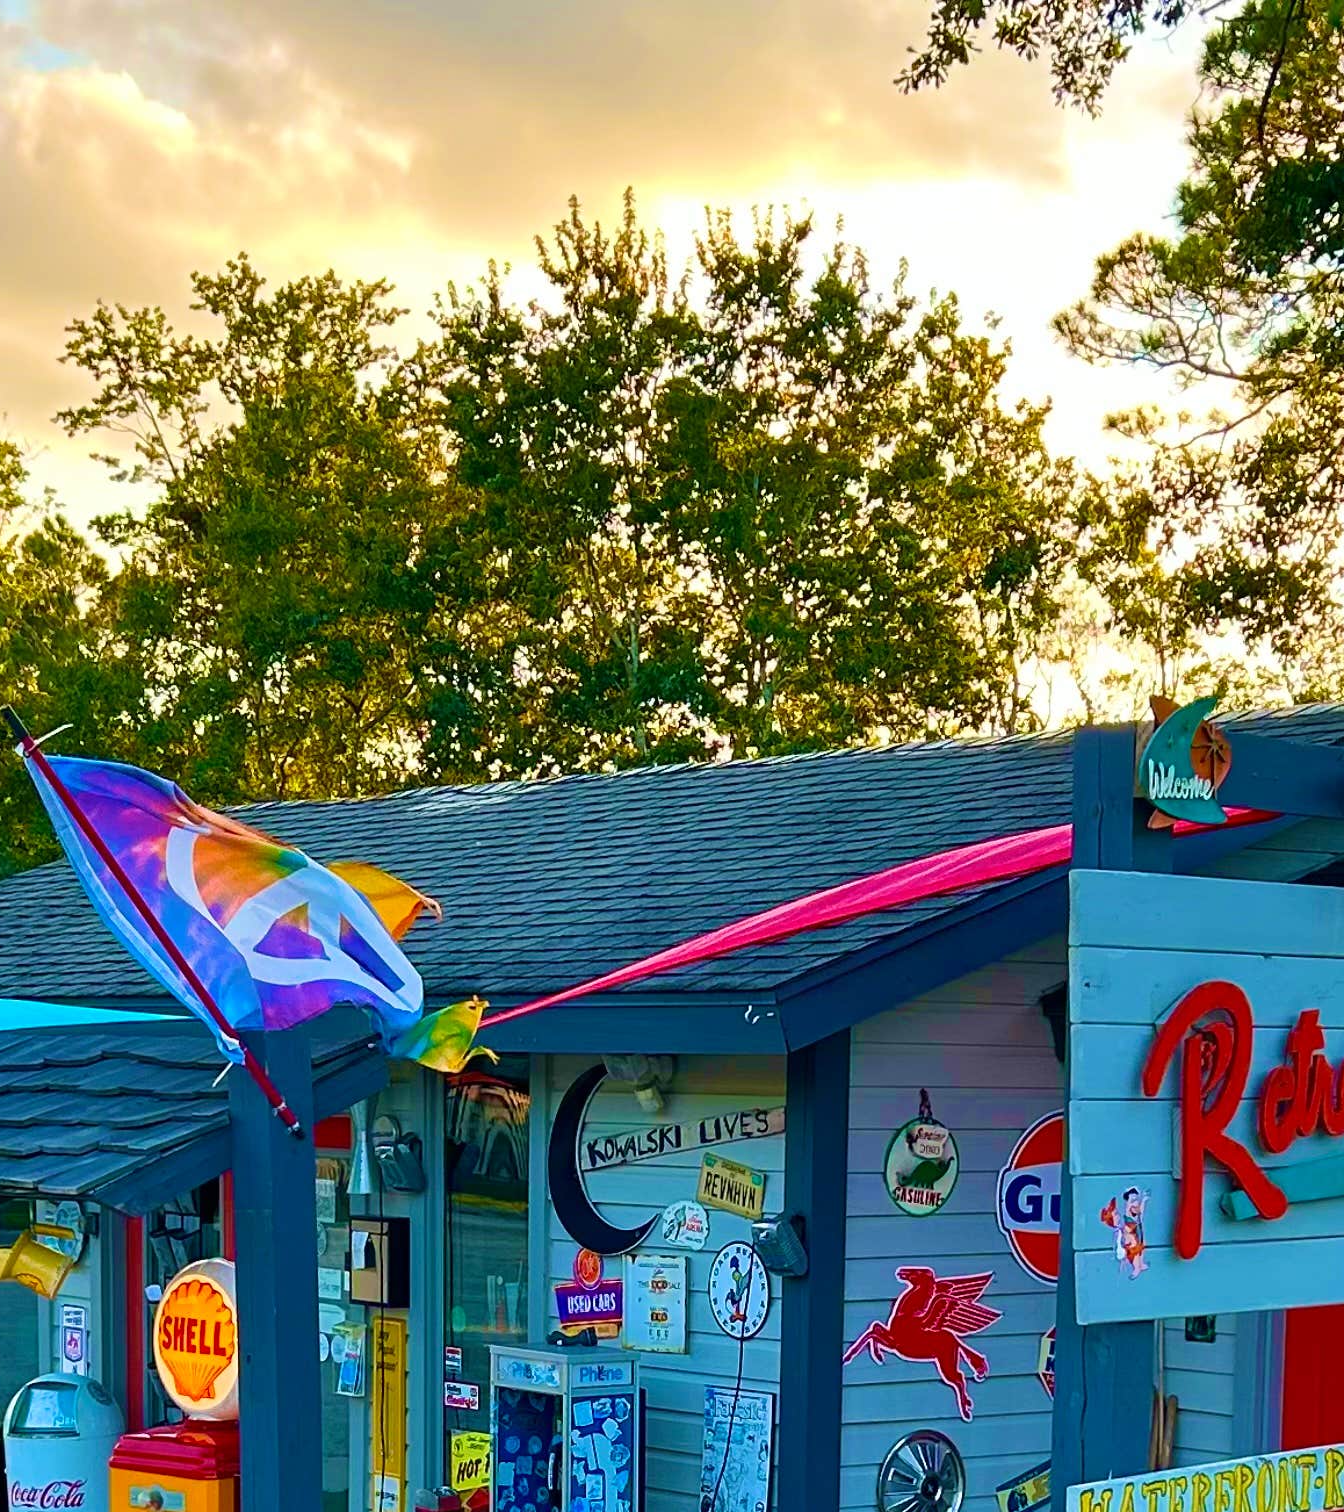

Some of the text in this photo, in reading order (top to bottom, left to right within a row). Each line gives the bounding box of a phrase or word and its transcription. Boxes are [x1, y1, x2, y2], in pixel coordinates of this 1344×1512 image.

[1148, 758, 1215, 800] Welcome
[587, 1110, 768, 1167] KOWALSKI LIVES
[567, 1292, 616, 1314] USED CARS
[162, 1314, 227, 1356] SHELL
[456, 1459, 482, 1483] HOT
